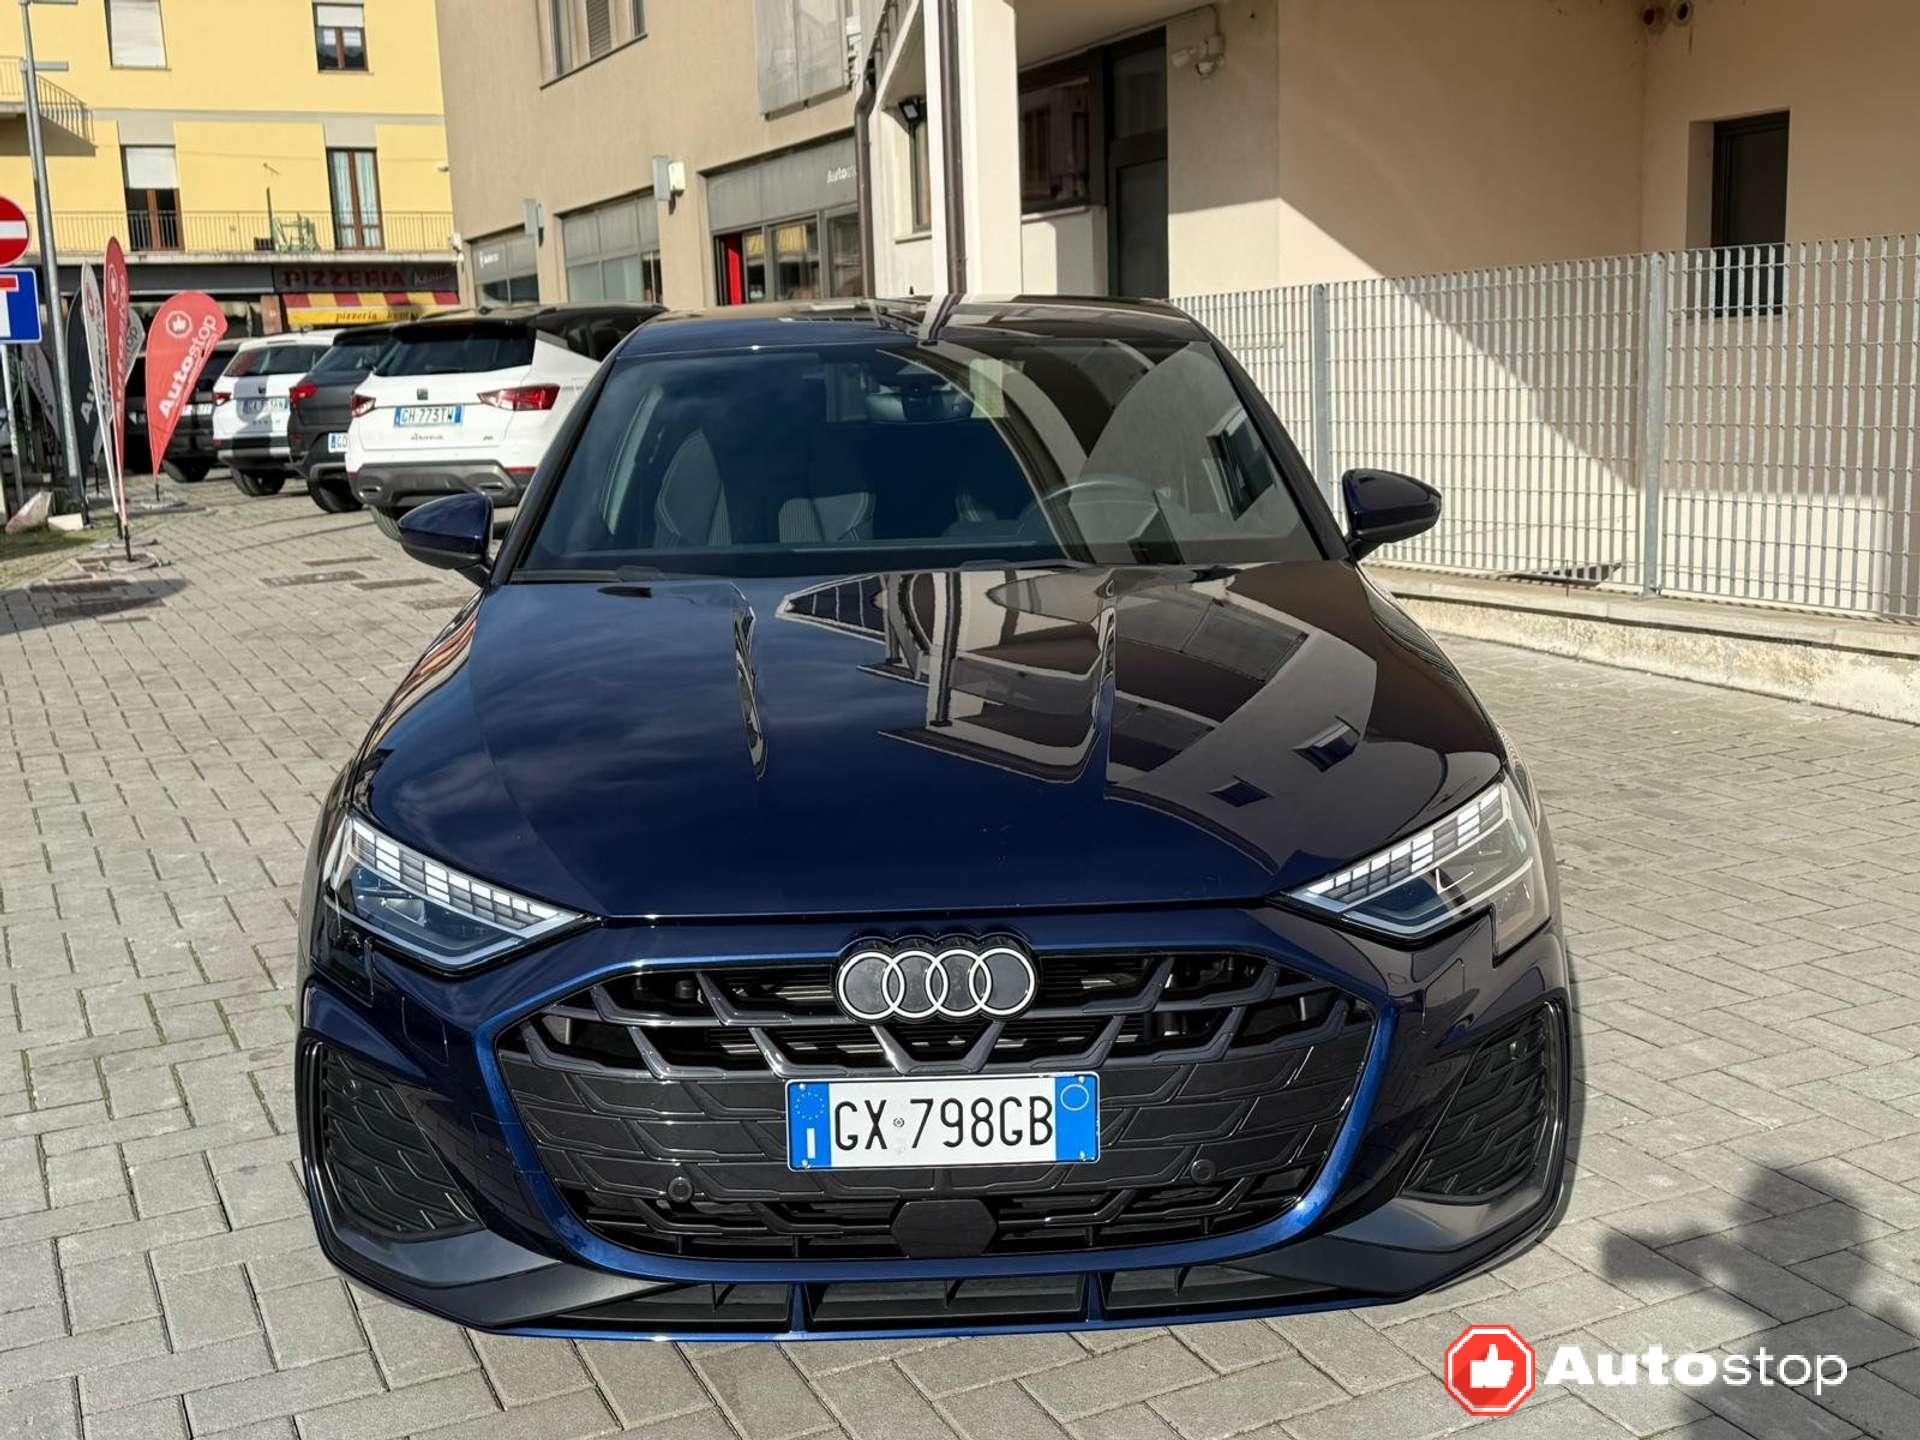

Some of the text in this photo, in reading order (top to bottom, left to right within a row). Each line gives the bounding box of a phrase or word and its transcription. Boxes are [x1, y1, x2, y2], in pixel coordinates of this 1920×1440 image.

[284, 270, 404, 287] PIZZERIA
[159, 315, 217, 418] Autostop
[834, 1098, 887, 1151] GX
[909, 1095, 1053, 1149] 798GB
